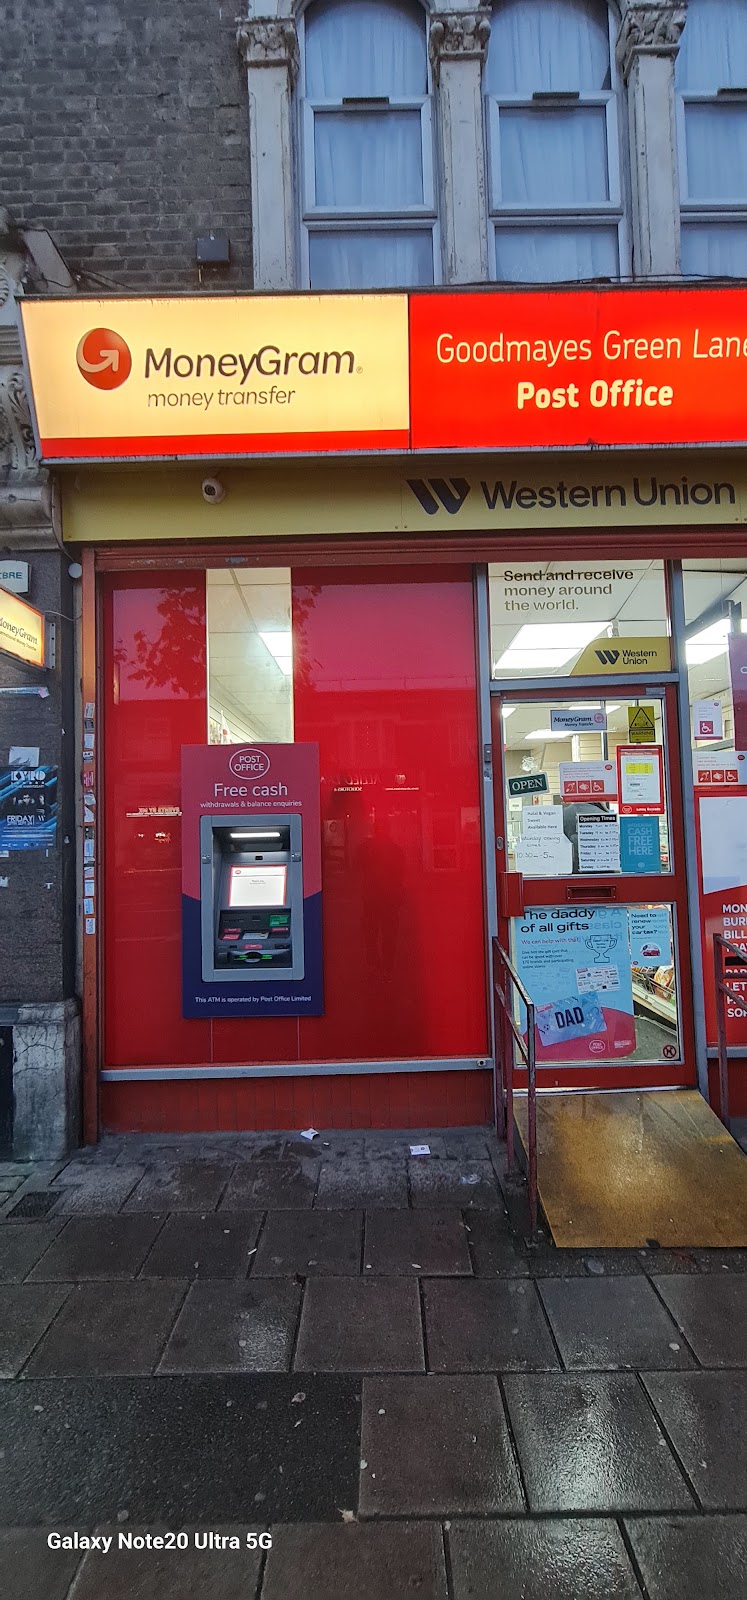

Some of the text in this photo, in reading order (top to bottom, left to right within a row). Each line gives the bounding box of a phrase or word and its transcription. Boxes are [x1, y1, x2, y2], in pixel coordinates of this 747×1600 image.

[436, 332, 592, 368] Goodmayes
[603, 330, 681, 360] Green
[144, 345, 356, 384] MoneyGram
[148, 386, 296, 410] money transfer
[518, 379, 674, 409] Post Office
[480, 476, 736, 510] Western Union
[504, 569, 634, 581] Send and receive
[504, 584, 612, 598] money around
[504, 599, 579, 610] the world.
[214, 782, 288, 796] Free cash
[512, 778, 543, 791] OPEN
[628, 836, 653, 845] FREE
[629, 846, 653, 856] HERE
[523, 910, 547, 920] The
[551, 909, 595, 919] daddy
[521, 922, 589, 933] of all gifts
[554, 1006, 584, 1028] DAD
